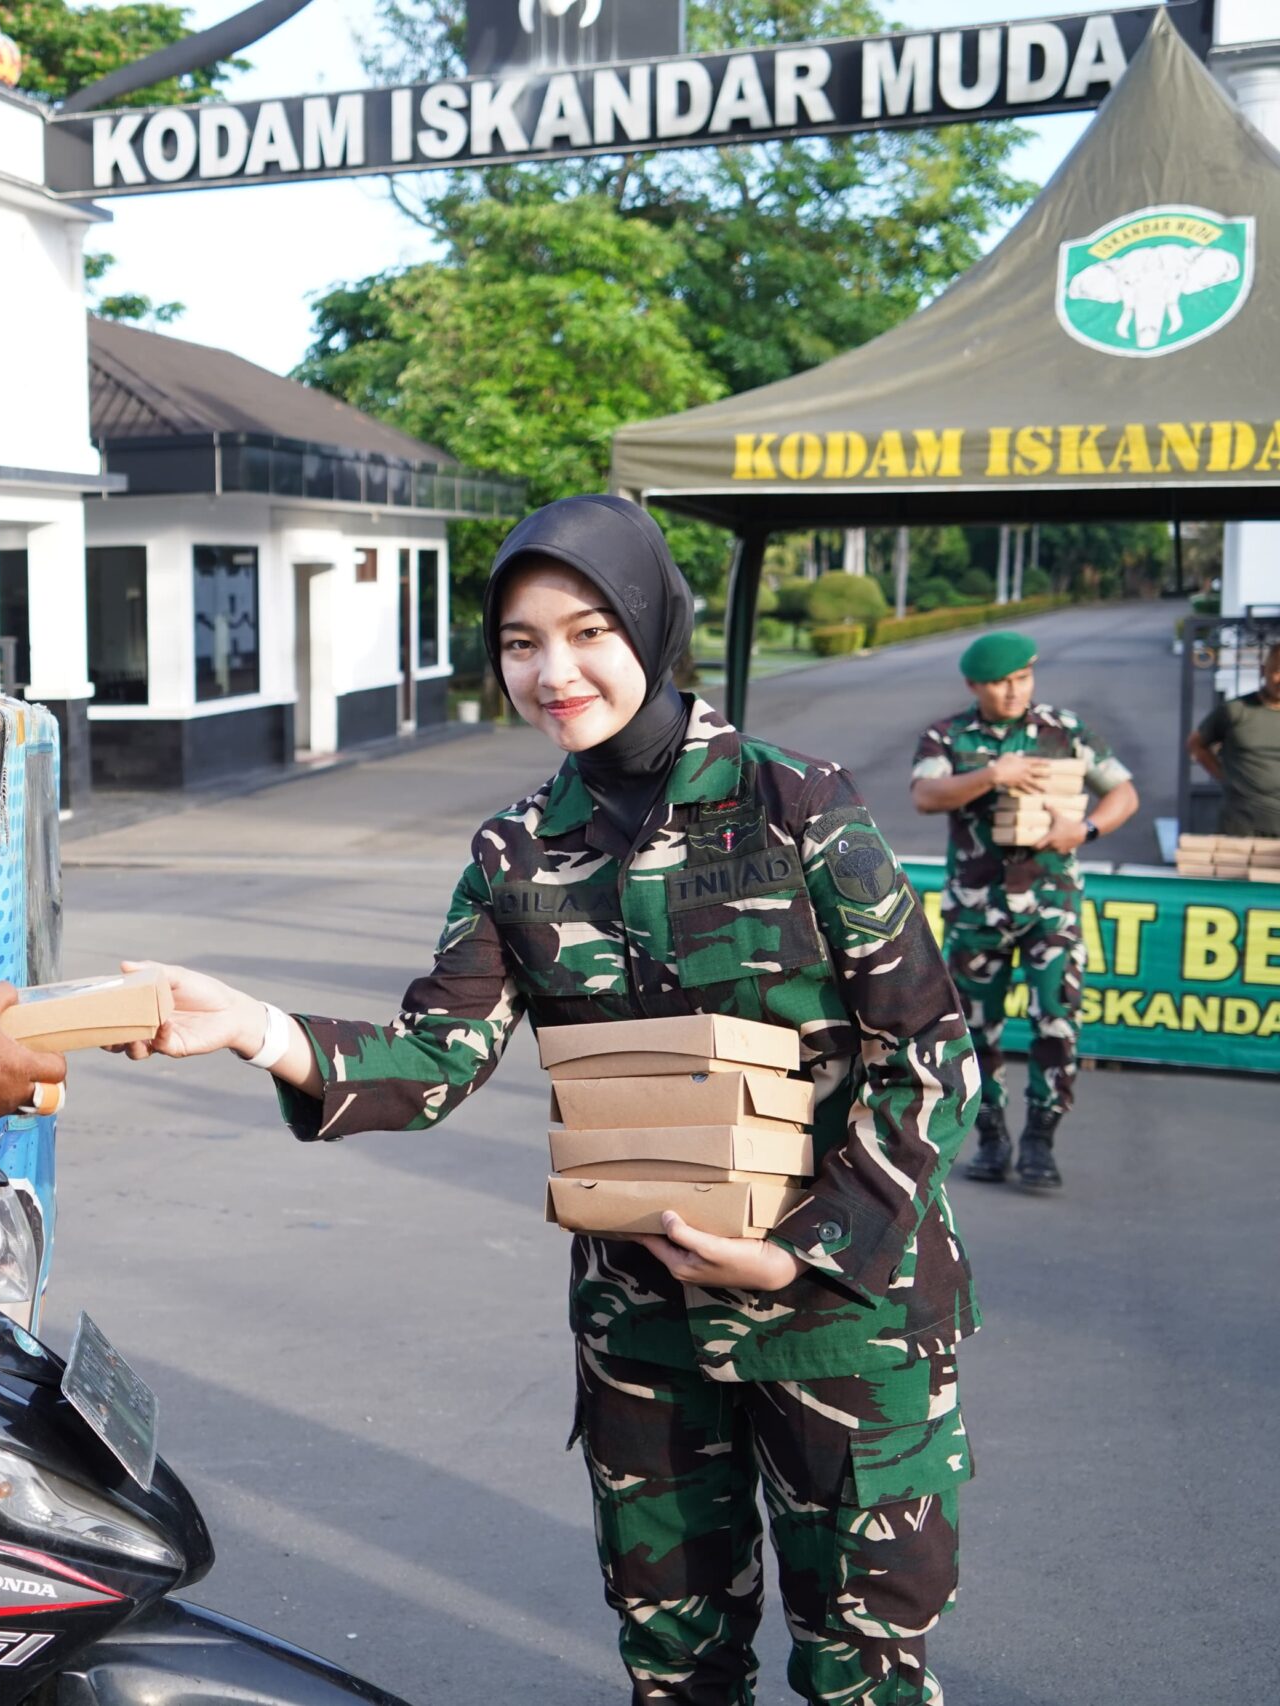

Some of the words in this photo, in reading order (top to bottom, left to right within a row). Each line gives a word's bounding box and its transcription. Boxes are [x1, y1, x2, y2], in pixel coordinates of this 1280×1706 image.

[92, 93, 365, 188] KODAM
[391, 47, 835, 163] ISKANDAR
[861, 14, 1128, 120] MUDA
[732, 429, 965, 480] KODAM
[674, 869, 729, 900] TNI
[742, 857, 792, 888] AD
[1081, 987, 1280, 1037] SKANDA
